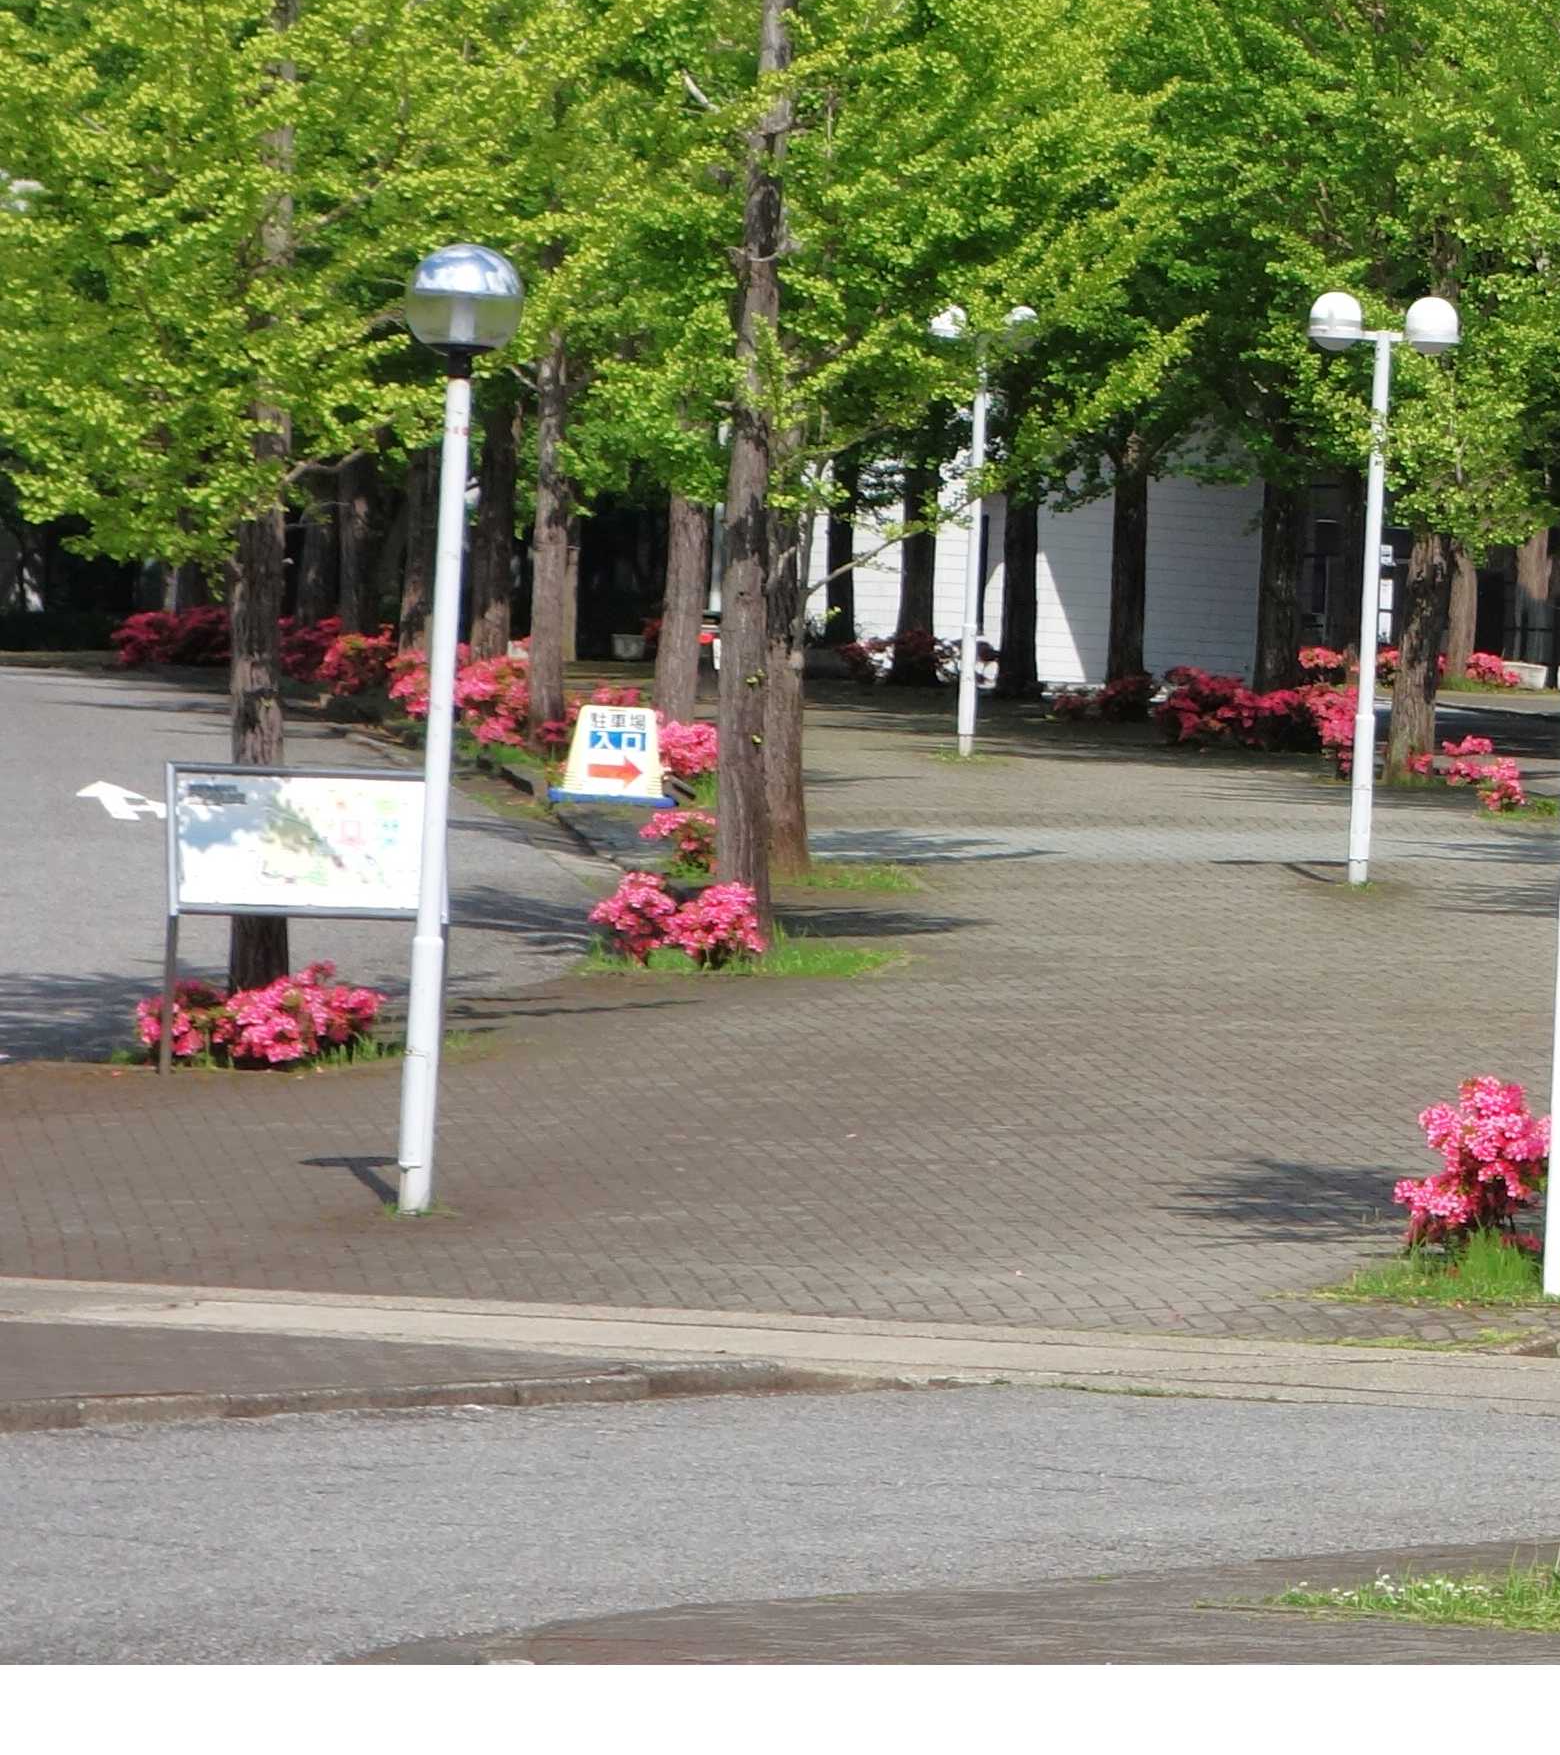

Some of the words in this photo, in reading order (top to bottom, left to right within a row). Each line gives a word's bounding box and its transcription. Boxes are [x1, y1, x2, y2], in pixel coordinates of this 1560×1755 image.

[590, 713, 646, 730] 駐車場
[591, 730, 644, 751] 入口
